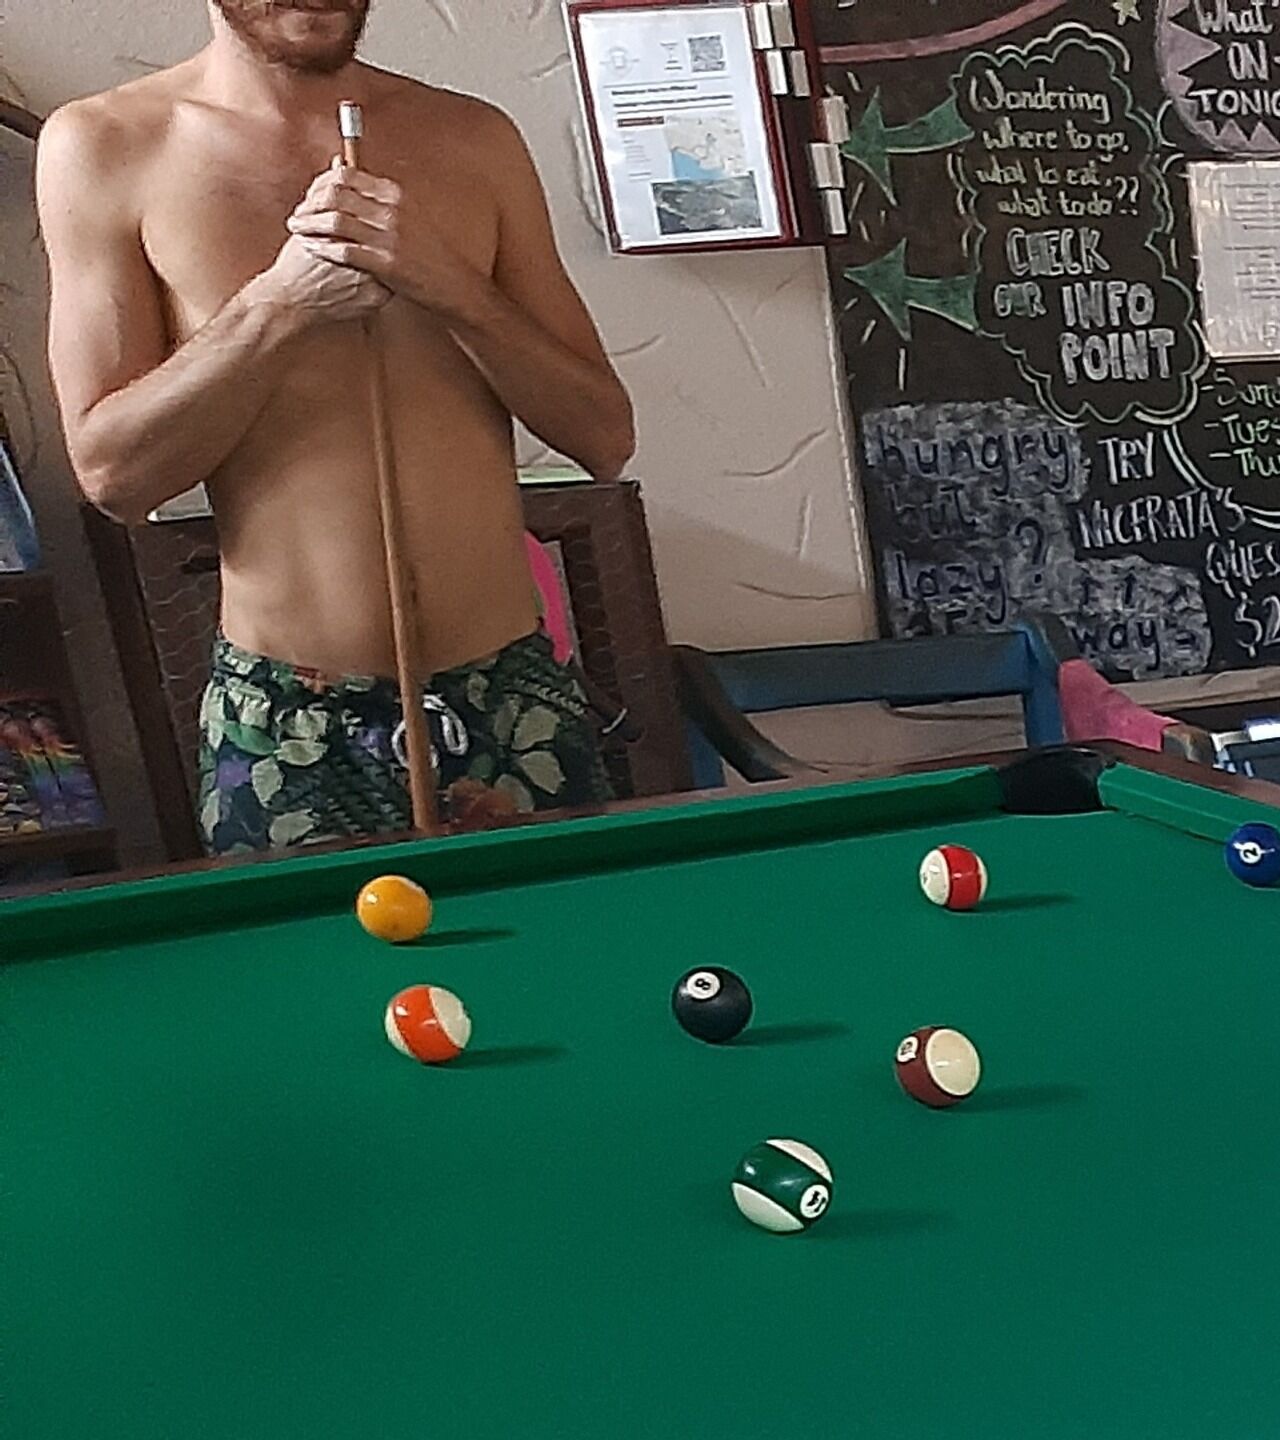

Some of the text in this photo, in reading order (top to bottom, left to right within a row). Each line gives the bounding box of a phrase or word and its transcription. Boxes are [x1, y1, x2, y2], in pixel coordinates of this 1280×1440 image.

[1228, 40, 1269, 81] ON
[983, 116, 1058, 149] where
[1066, 119, 1091, 149] to
[975, 155, 1027, 184] what
[1034, 157, 1059, 185] to
[998, 188, 1051, 217] what
[1006, 227, 1111, 277] CHECK
[1061, 280, 1155, 329] INFO
[1059, 328, 1175, 385] POINT
[876, 424, 1070, 496] hungry
[1098, 432, 1153, 485] TRY
[896, 552, 1007, 626] lazy
[1243, 847, 1258, 859] 2
[695, 978, 711, 991] 8
